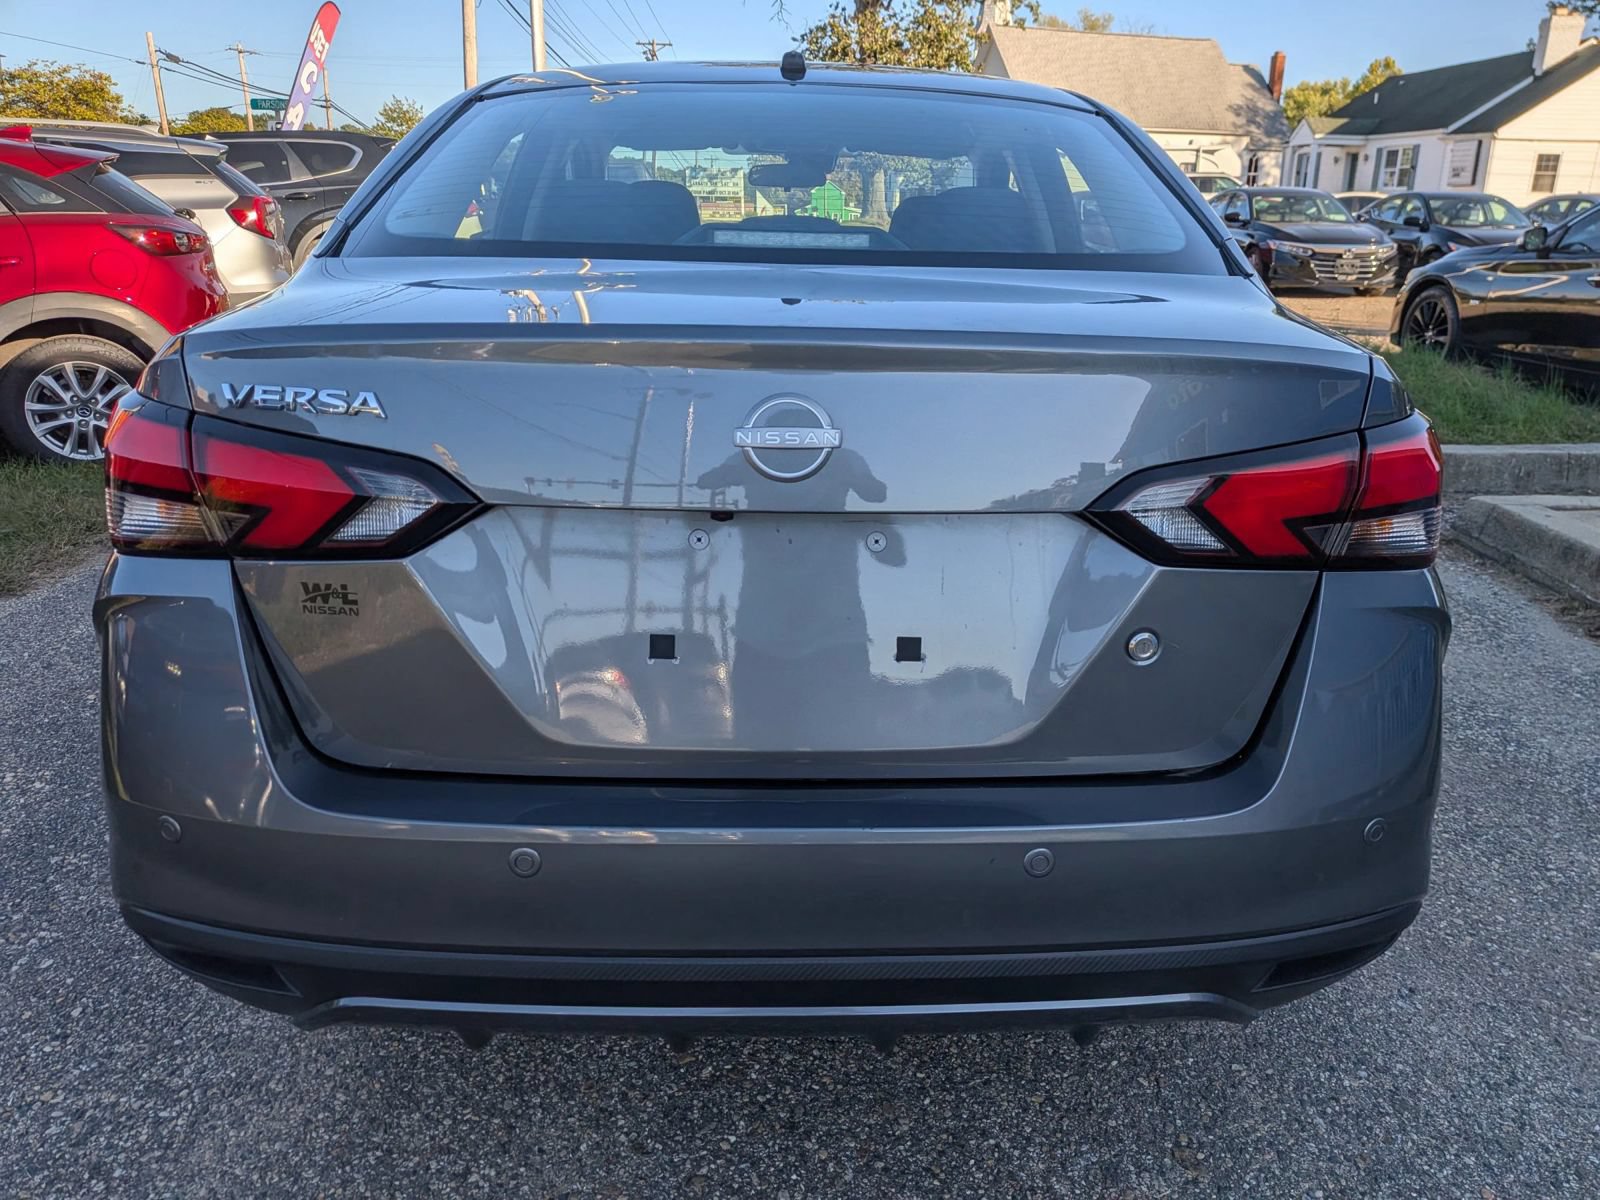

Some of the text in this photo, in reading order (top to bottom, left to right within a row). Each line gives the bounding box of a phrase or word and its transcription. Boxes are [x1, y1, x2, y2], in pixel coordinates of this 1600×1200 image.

[221, 383, 388, 419] VERSA
[736, 431, 839, 445] NISSAN
[302, 605, 360, 617] NISSAN
